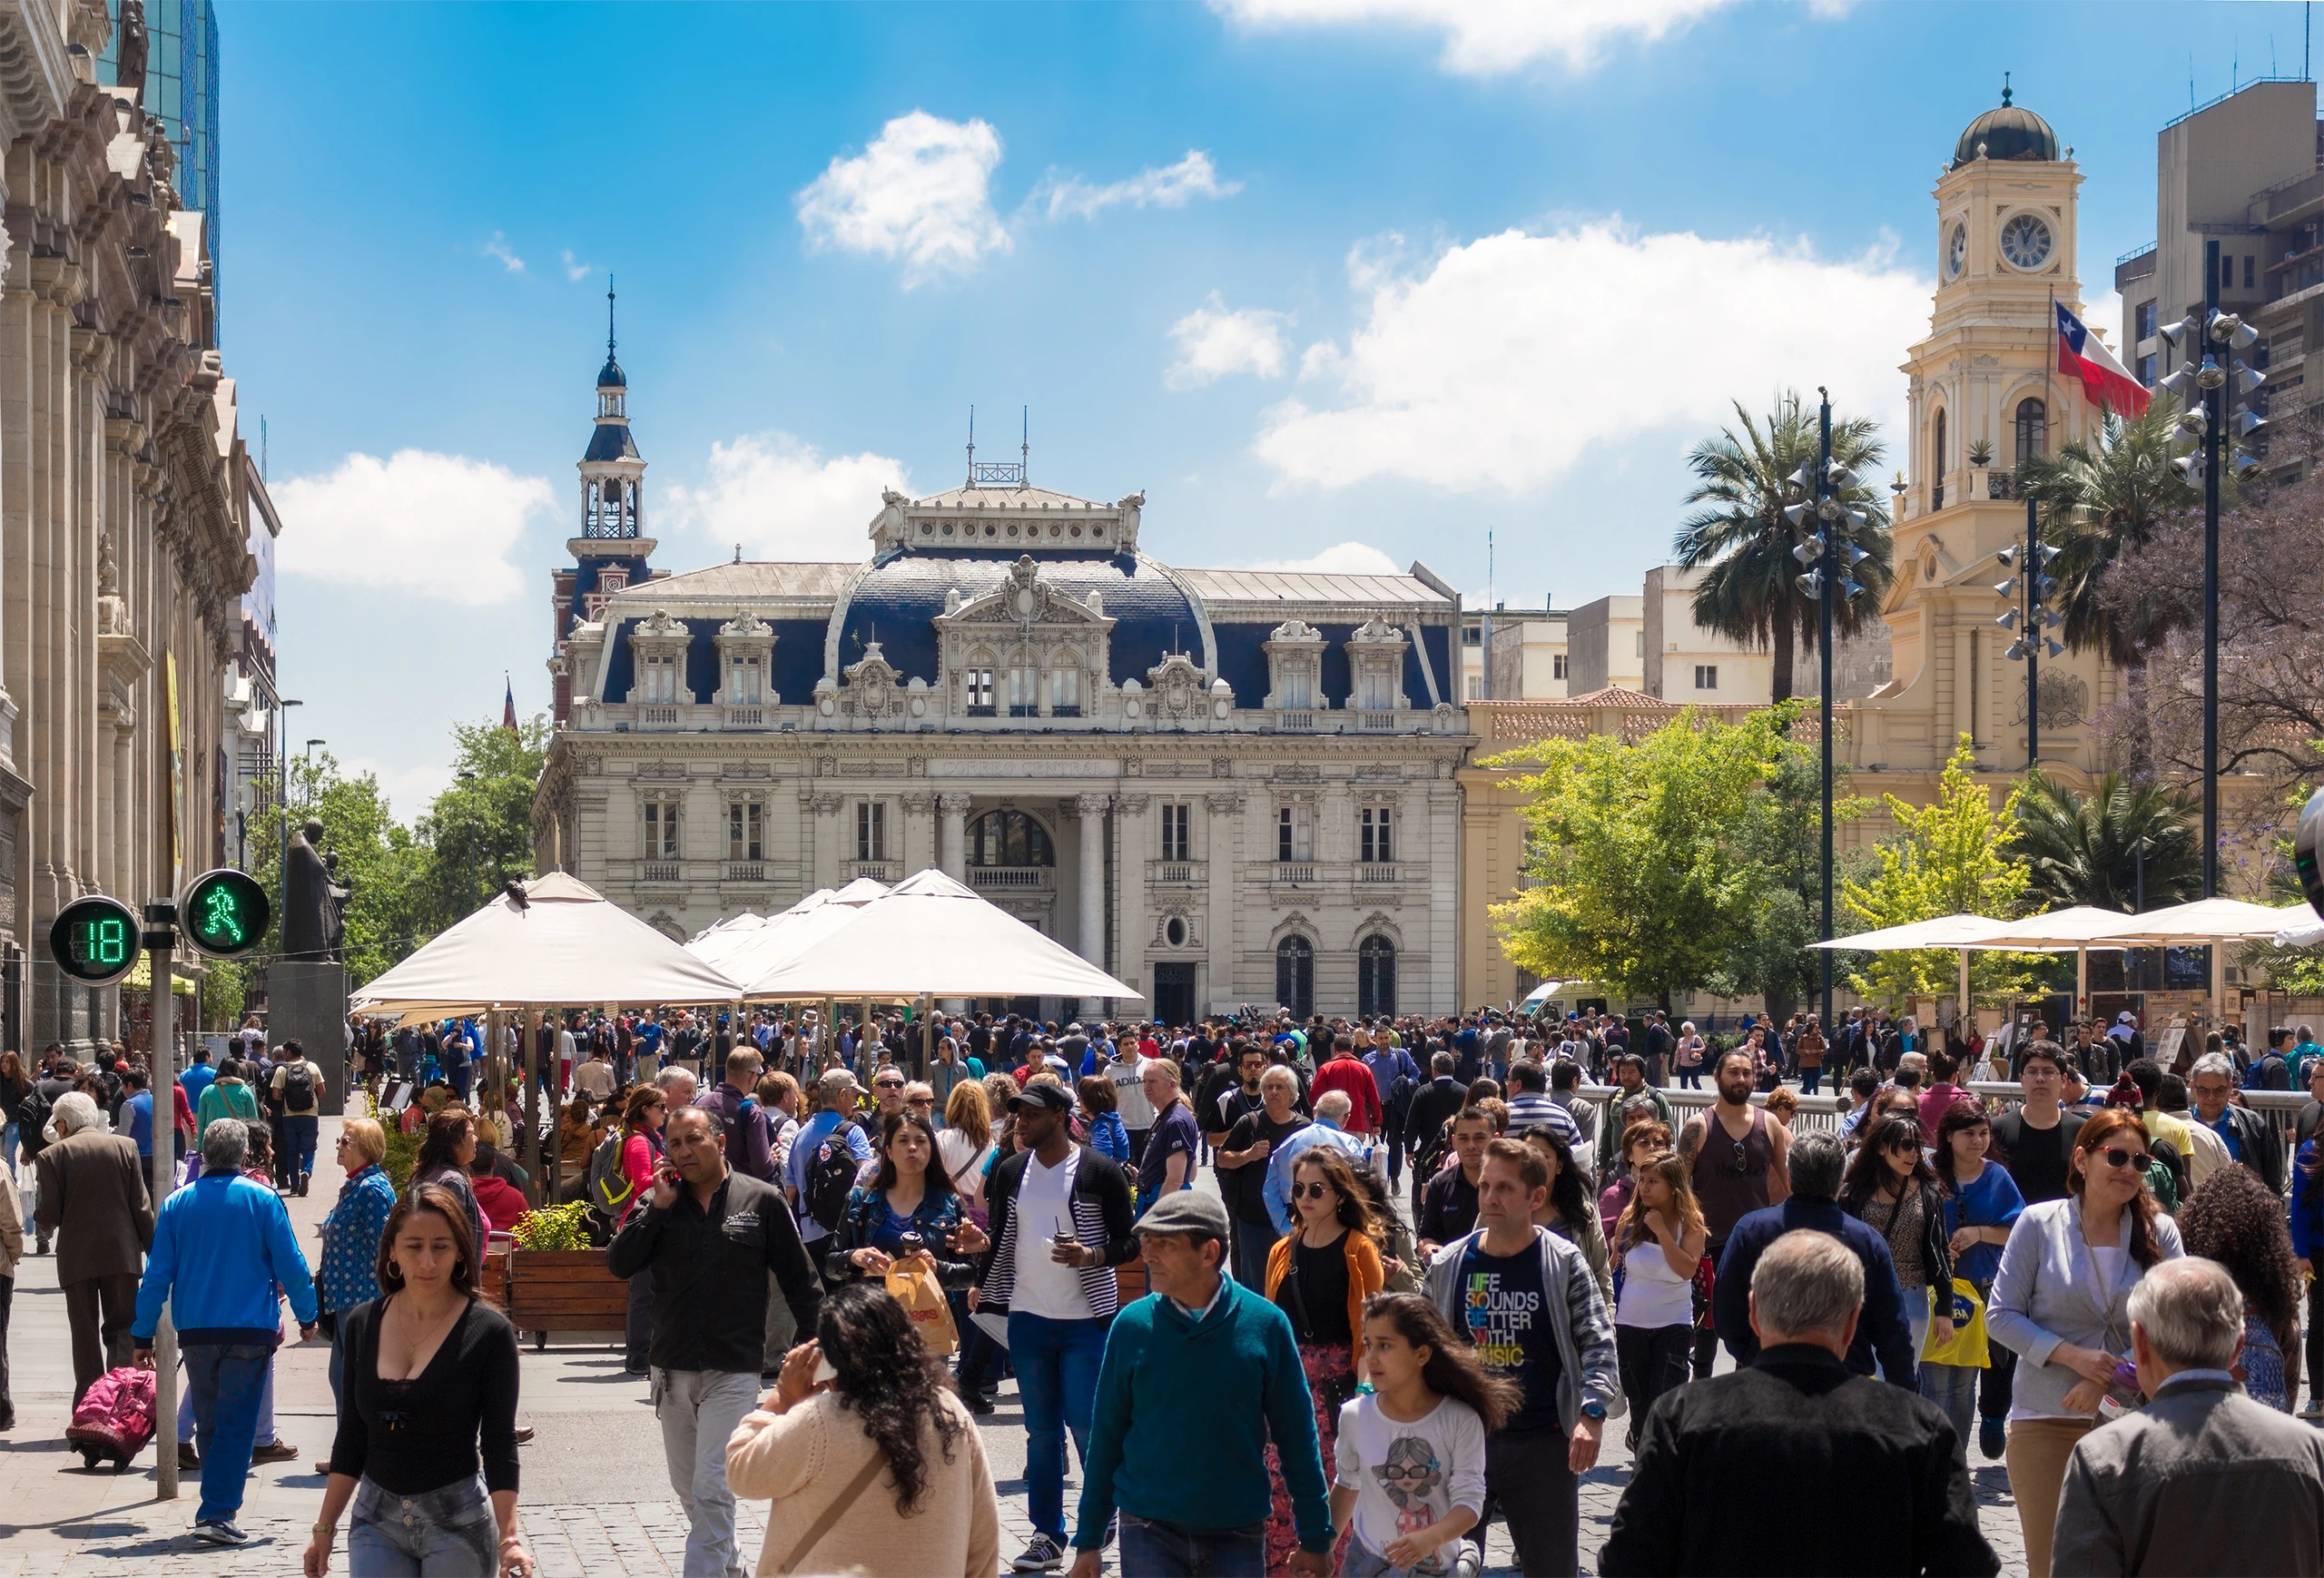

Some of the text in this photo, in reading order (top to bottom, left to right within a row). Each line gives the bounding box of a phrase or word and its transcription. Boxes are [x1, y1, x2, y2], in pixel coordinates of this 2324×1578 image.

[943, 761, 1106, 775] CORREO CENTRAL
[90, 920, 123, 962] 18
[1116, 1077, 1144, 1088] ADID
[1466, 1273, 1501, 1292] LIFE
[1465, 1291, 1540, 1311] SOUNDS
[1465, 1311, 1531, 1329] BETTER
[1953, 1308, 1969, 1319] BA
[1469, 1328, 1516, 1347] WITH
[1475, 1347, 1524, 1367] MUSIC
